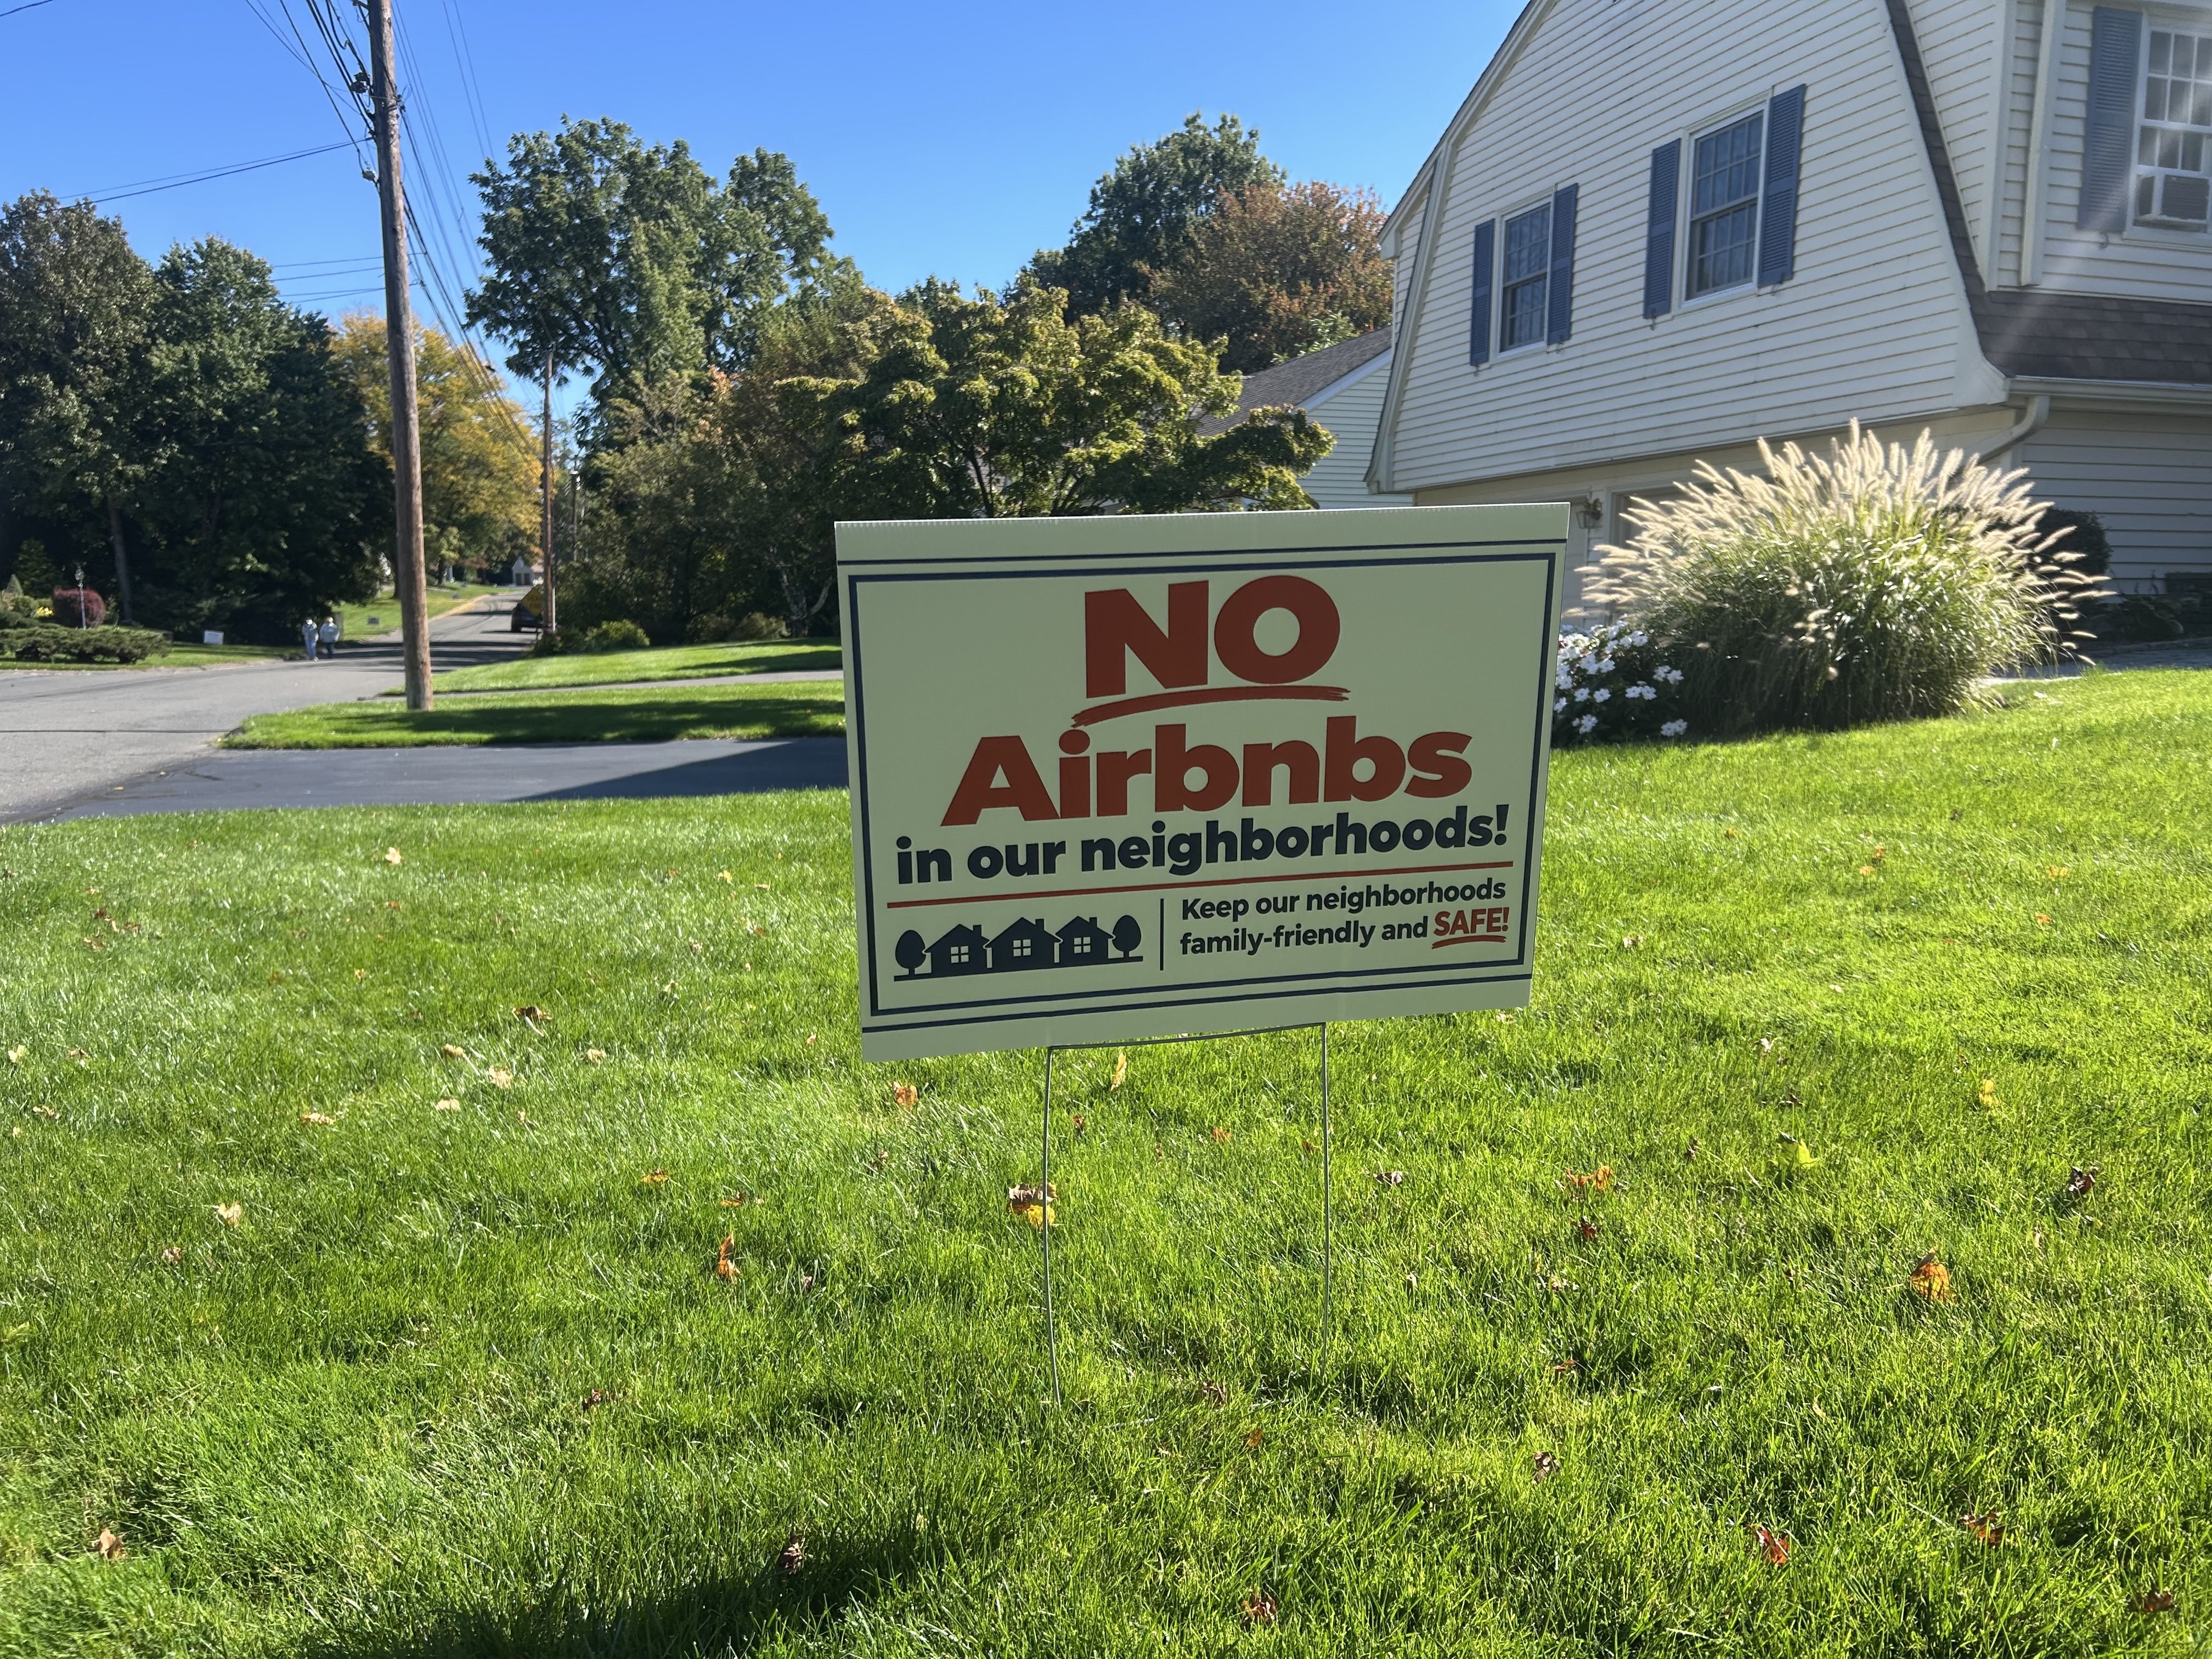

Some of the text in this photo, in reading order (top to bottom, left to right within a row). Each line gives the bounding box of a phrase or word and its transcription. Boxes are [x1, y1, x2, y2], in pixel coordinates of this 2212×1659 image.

[1084, 574, 1340, 699] NO
[940, 715, 1473, 827] Airbnbs
[896, 804, 1510, 885] in our neighborhoods!
[1180, 906, 1510, 956] family-friendly and SAFE!
[1182, 877, 1506, 922] Keep our neighborhoods
